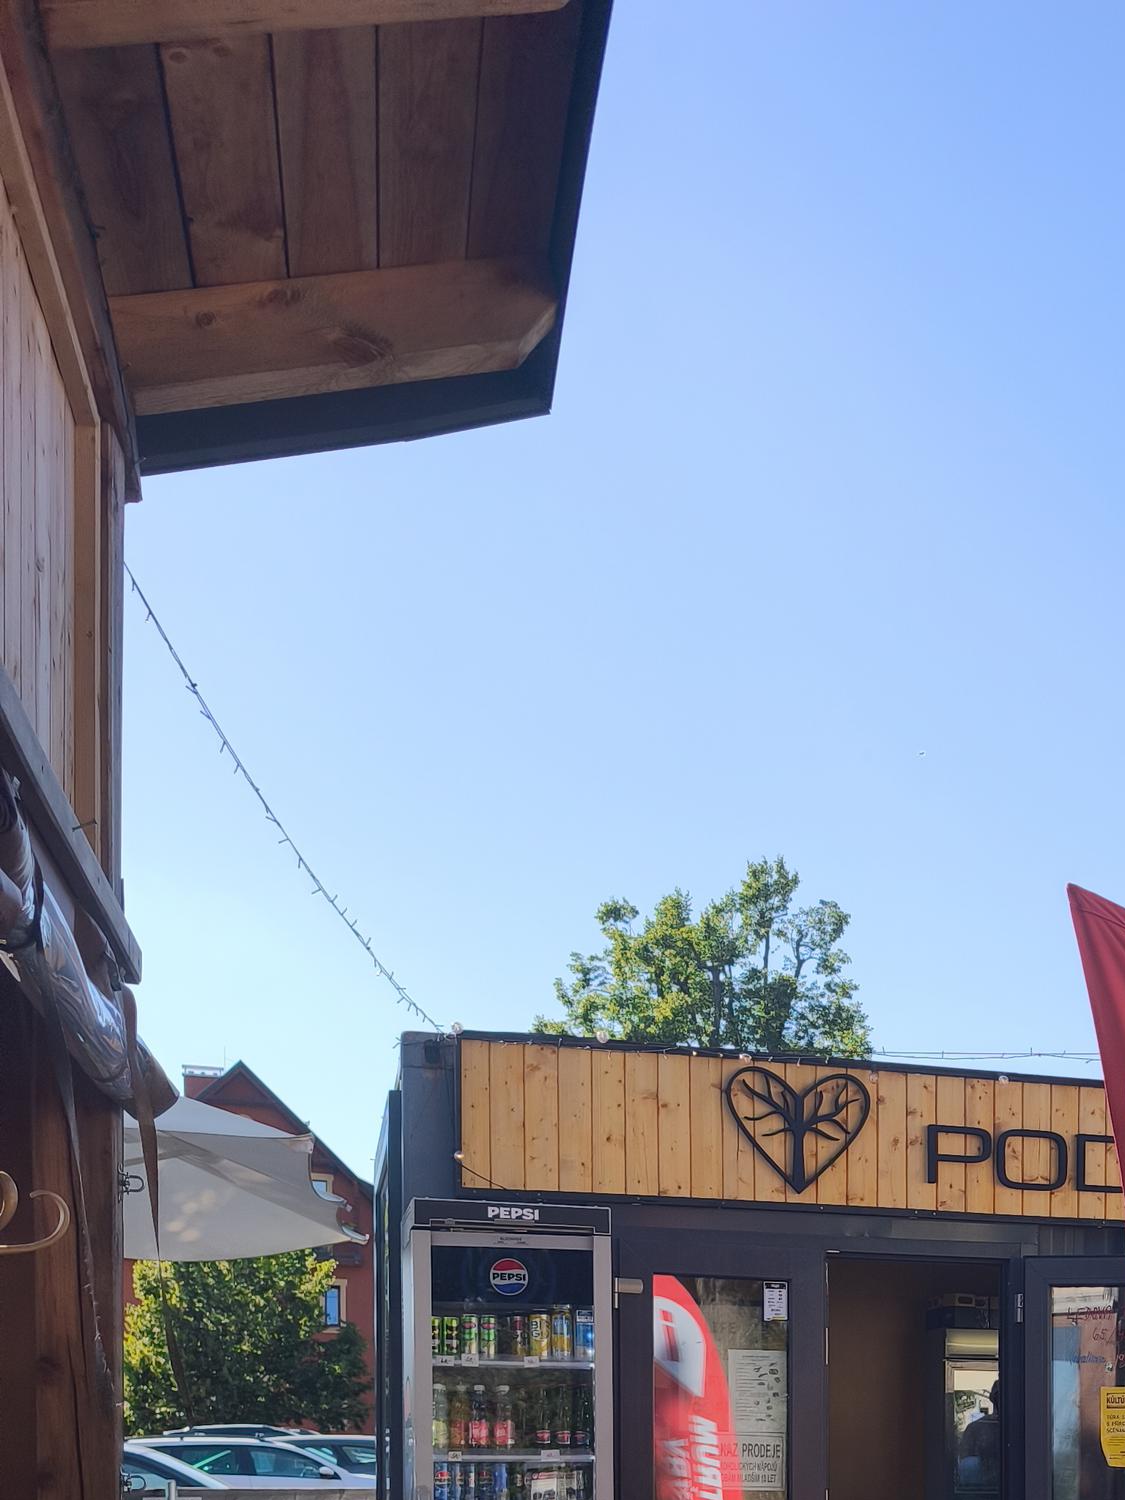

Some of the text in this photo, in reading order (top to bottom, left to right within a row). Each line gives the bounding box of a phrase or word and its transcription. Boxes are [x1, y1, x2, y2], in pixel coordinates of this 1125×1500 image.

[487, 1206, 539, 1221] PEPSI
[492, 1272, 526, 1281] PEPSI
[742, 1443, 781, 1458] PRODEJE
